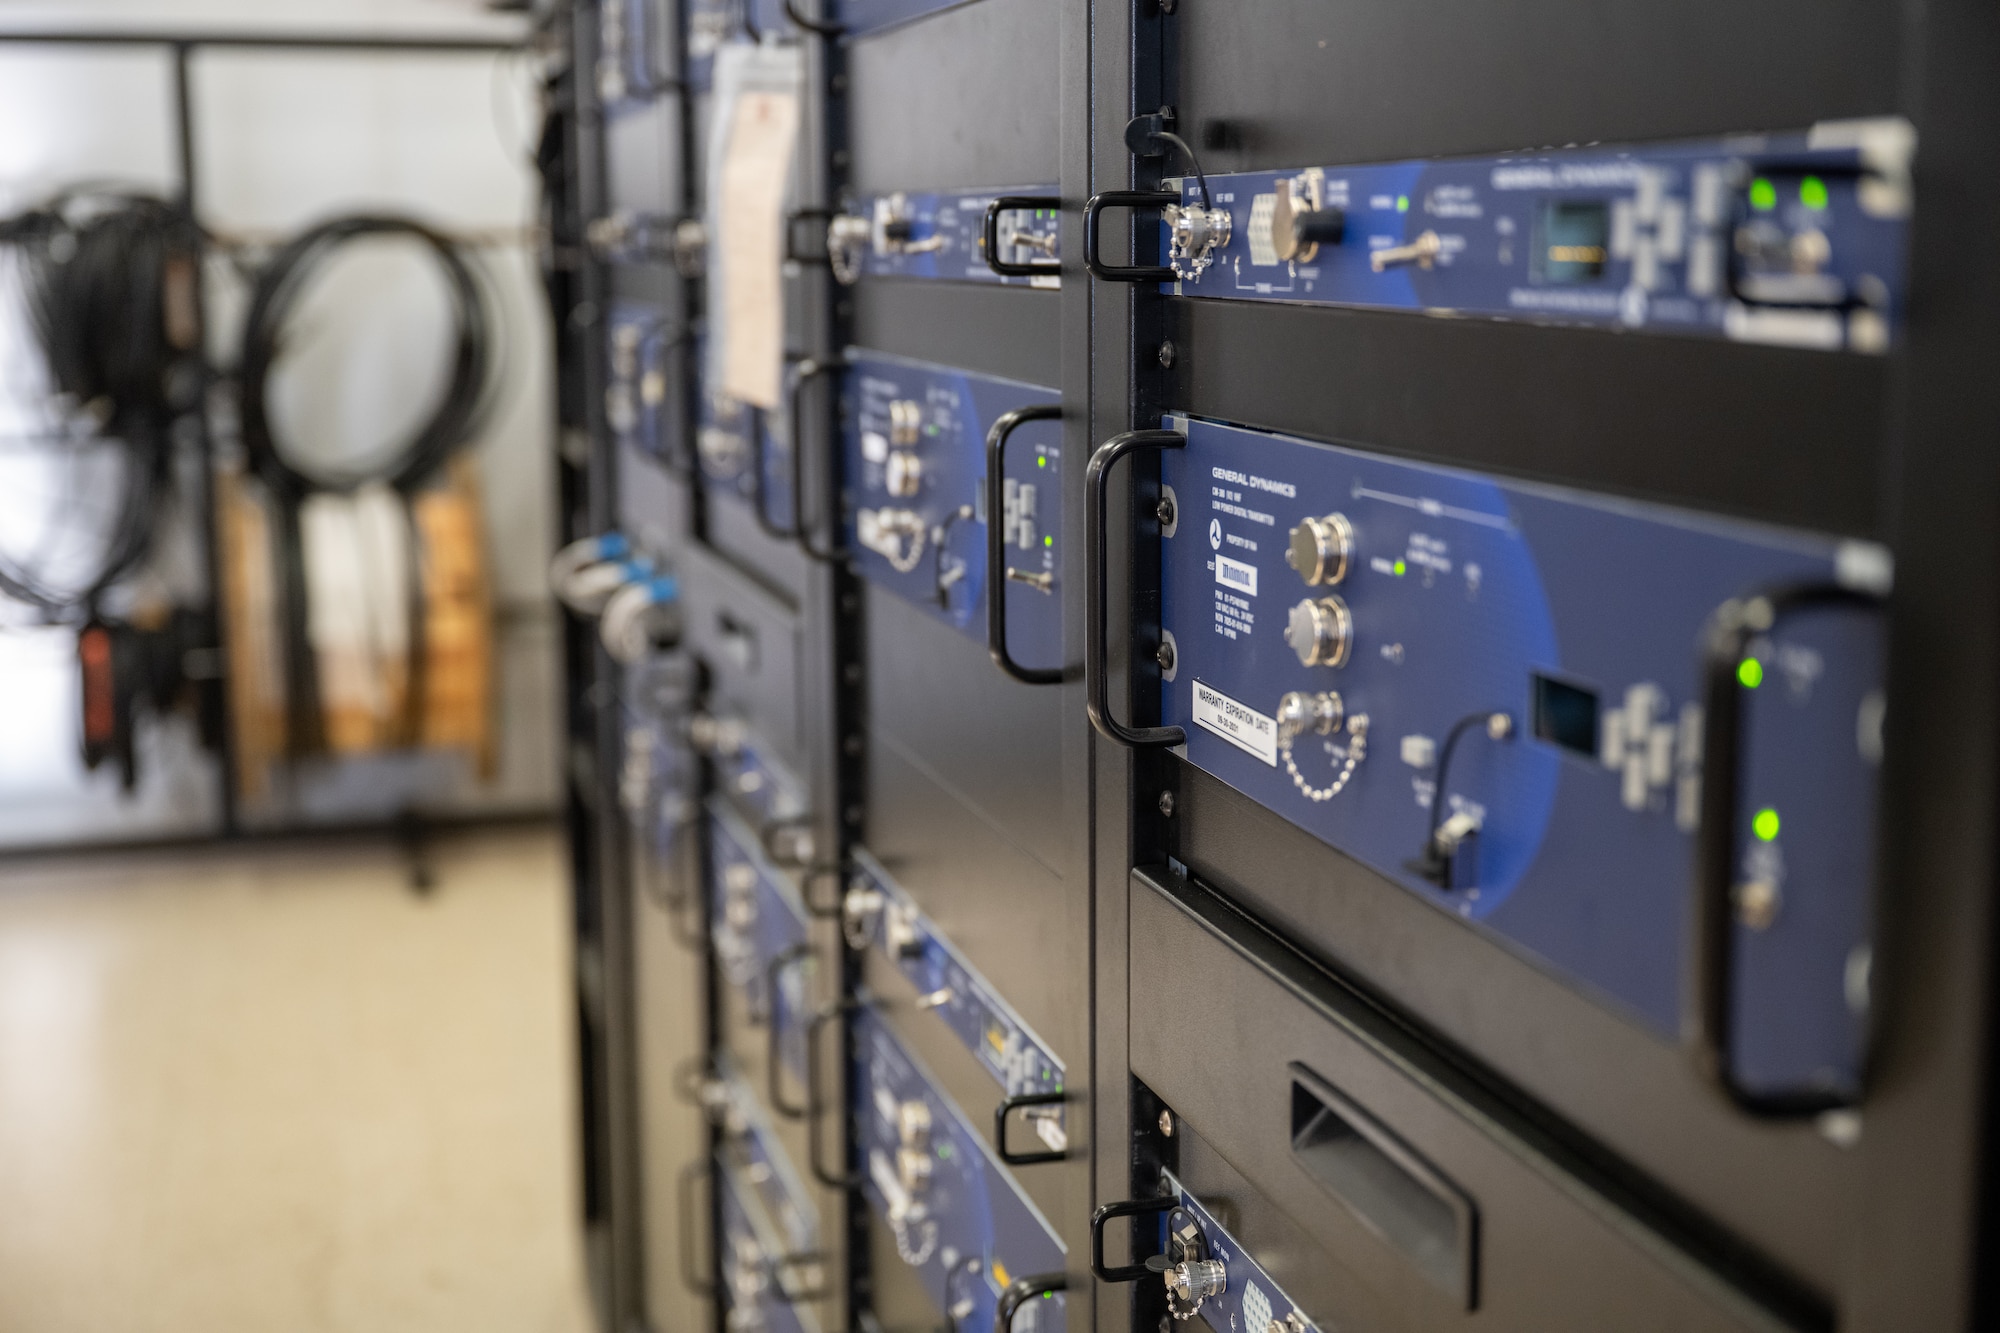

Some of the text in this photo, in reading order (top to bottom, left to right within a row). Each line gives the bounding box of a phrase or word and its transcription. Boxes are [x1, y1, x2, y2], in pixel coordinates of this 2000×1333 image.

[1212, 466, 1296, 498] GENERAL DYNAMICS
[1199, 687, 1269, 735] WARRANTY EXPIRATION DATE
